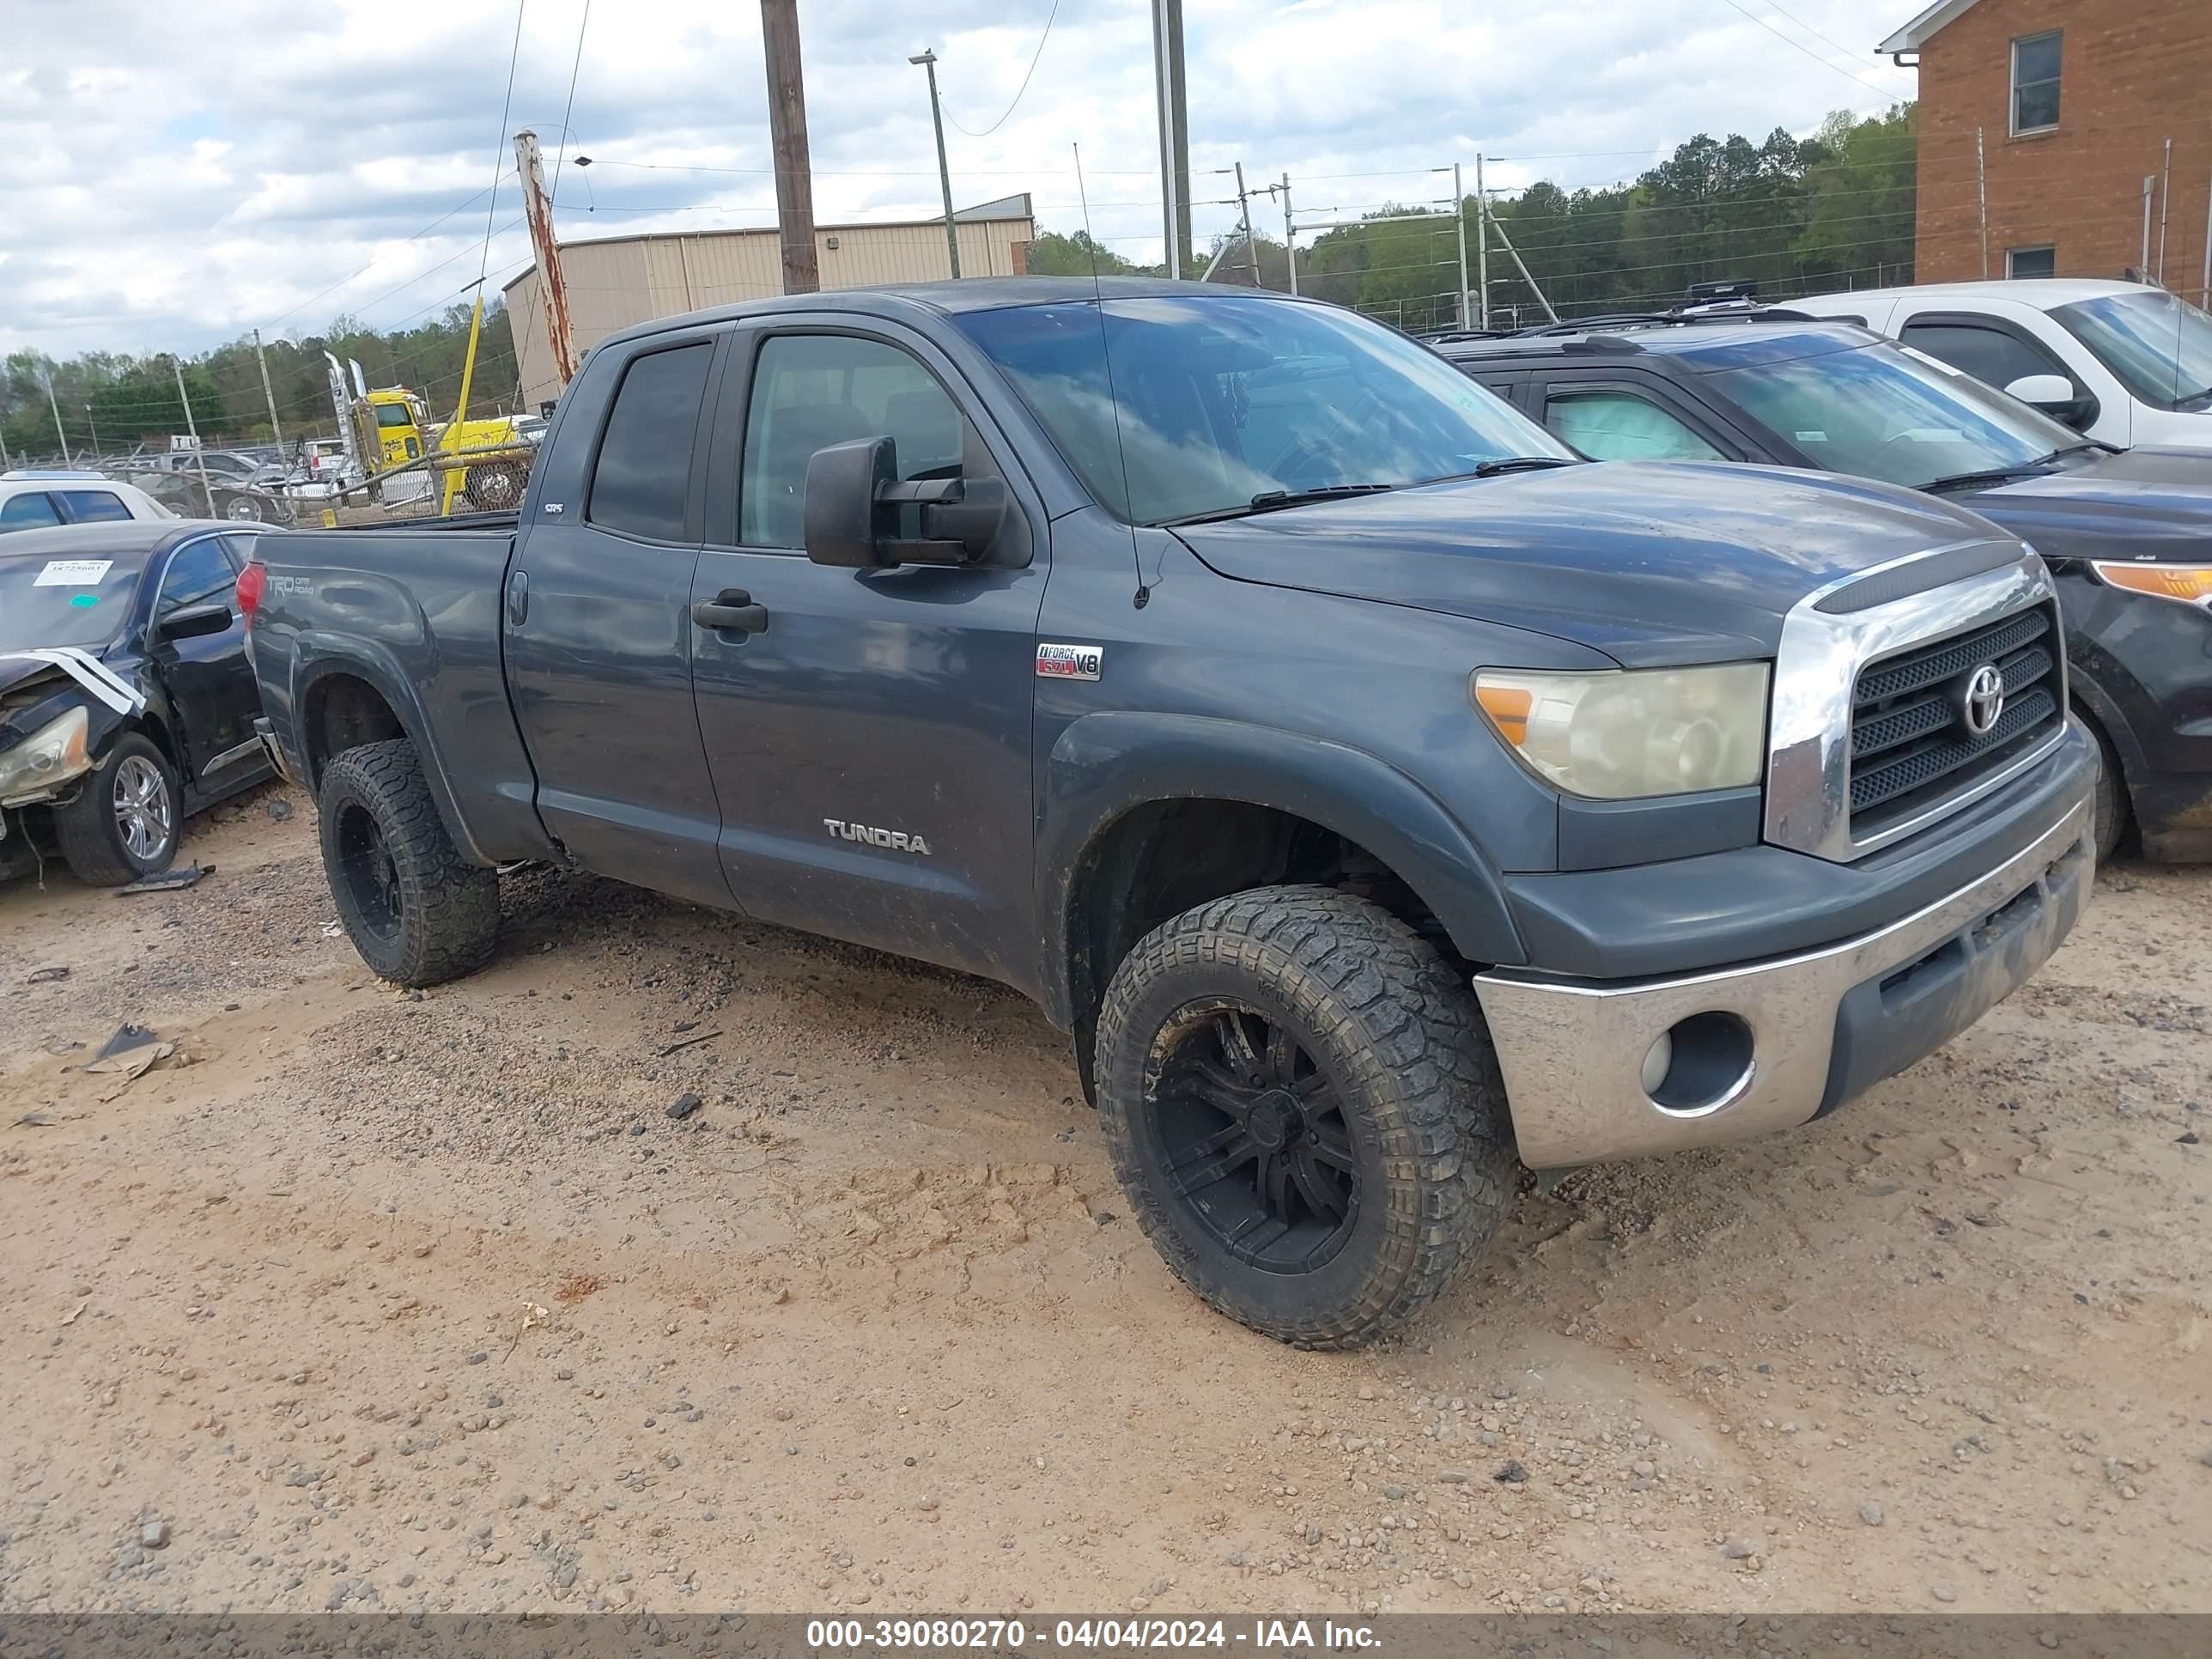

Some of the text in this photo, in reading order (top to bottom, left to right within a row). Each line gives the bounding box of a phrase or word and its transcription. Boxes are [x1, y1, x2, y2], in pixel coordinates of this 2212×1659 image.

[544, 503, 564, 514] SR5
[266, 575, 295, 598] TRD
[294, 586, 314, 595] ROAD
[1075, 653, 1098, 674] V8
[823, 817, 933, 855] TUNDRA
